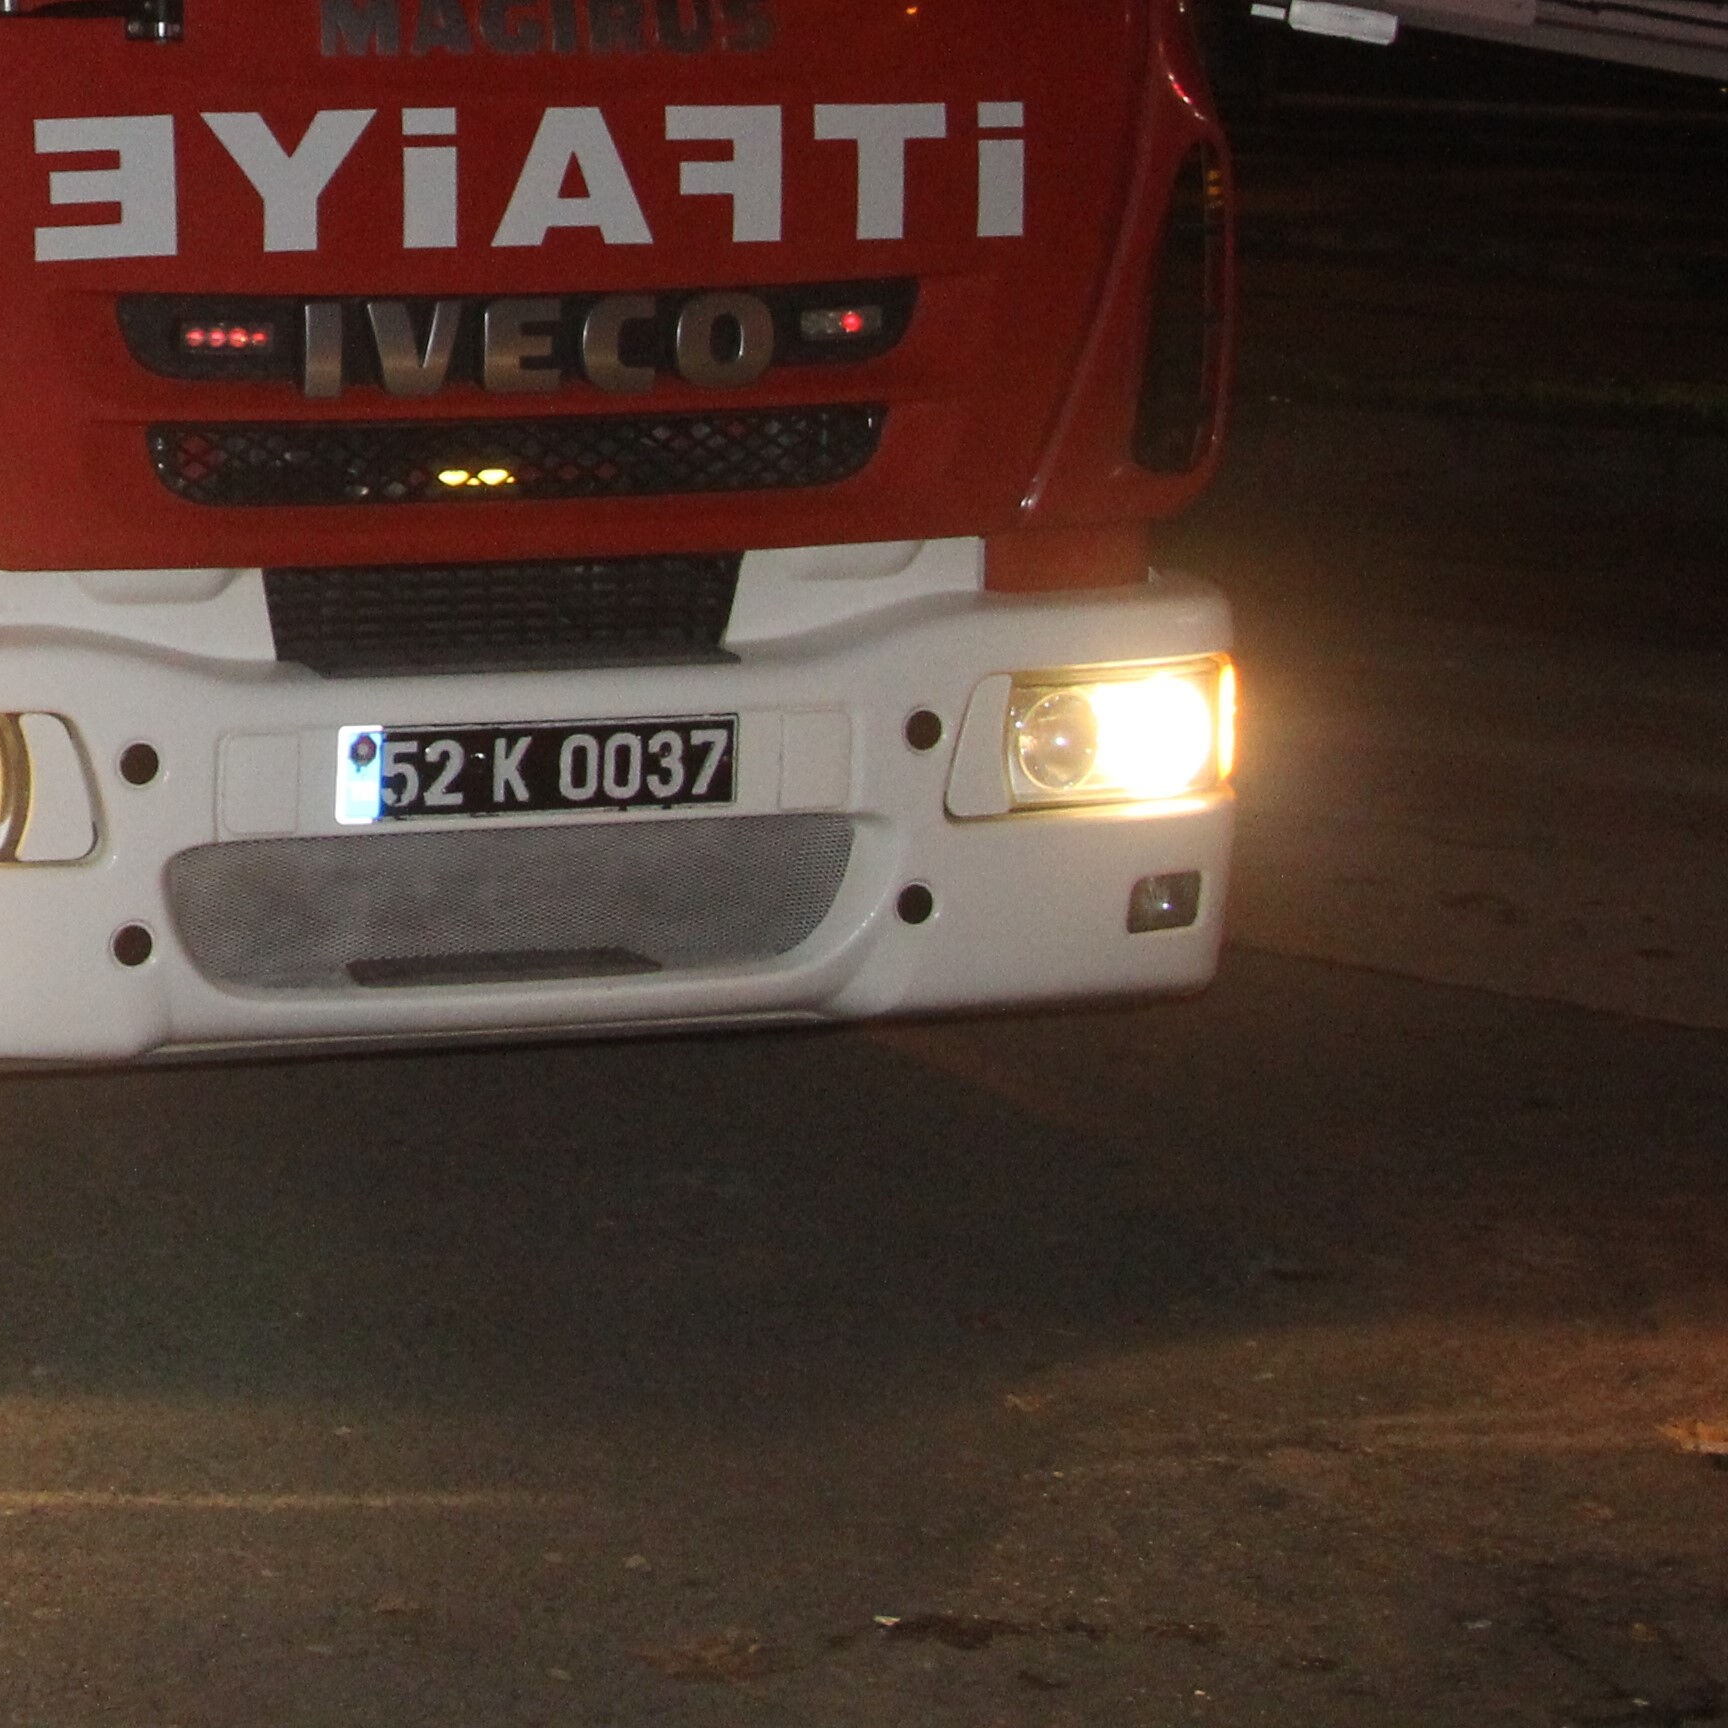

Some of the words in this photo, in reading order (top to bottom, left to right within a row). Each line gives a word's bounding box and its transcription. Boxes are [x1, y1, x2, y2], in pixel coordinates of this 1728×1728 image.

[301, 289, 776, 397] IVECO
[382, 738, 466, 807] 52
[492, 735, 532, 803] K
[558, 728, 728, 801] 0037
